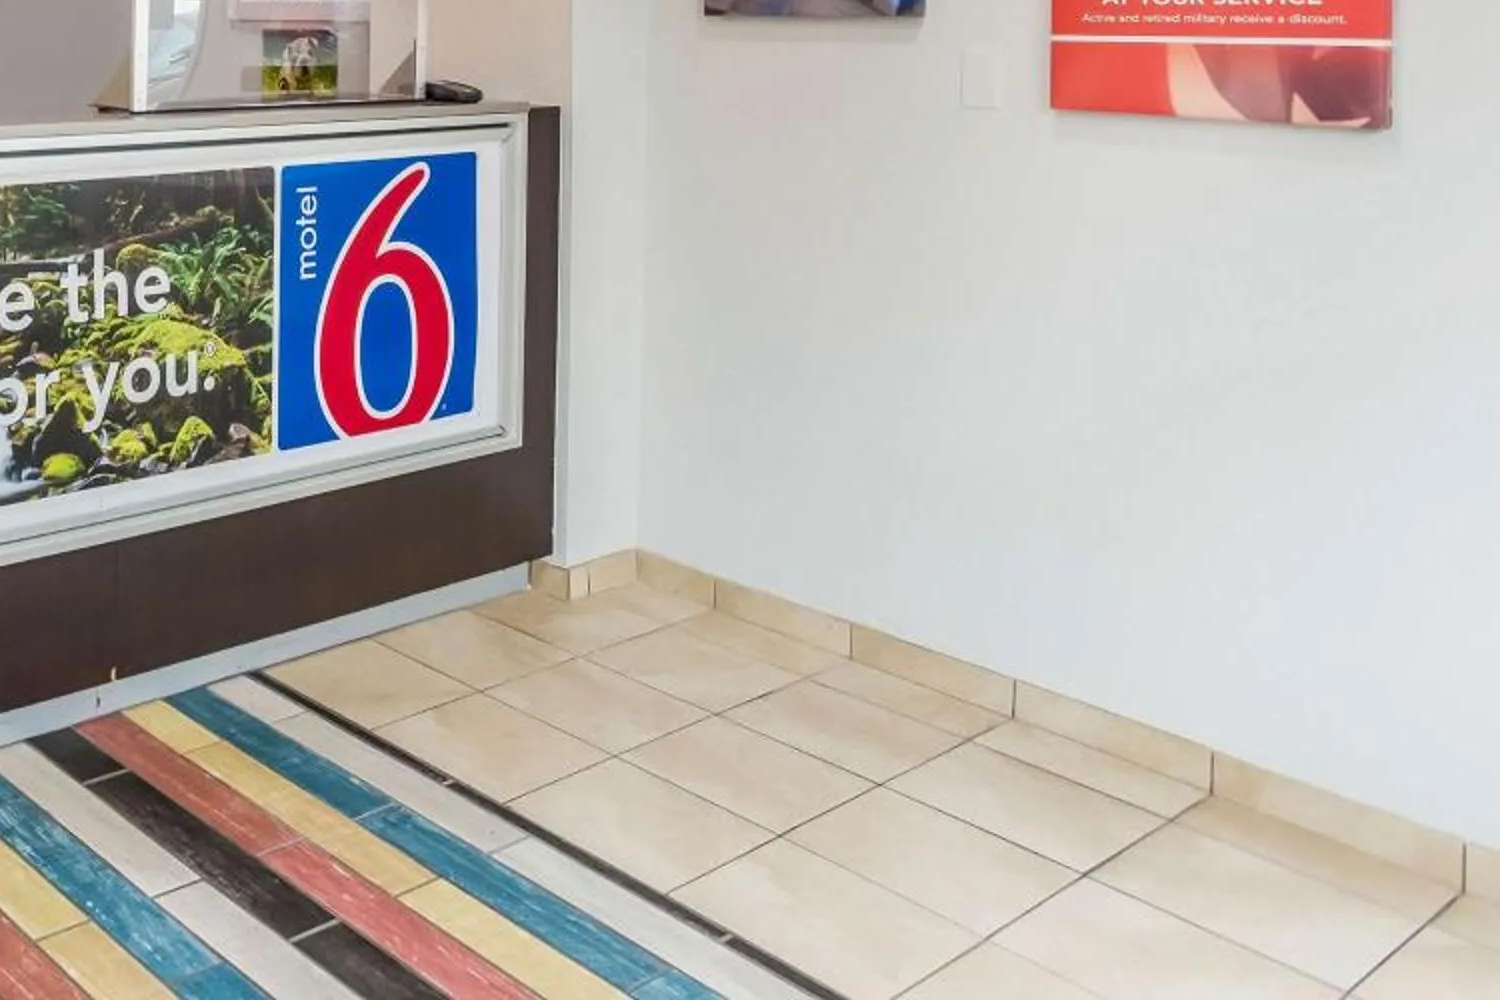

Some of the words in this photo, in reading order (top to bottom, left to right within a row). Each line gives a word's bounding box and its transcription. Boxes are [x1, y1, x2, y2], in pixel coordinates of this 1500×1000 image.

[1082, 12, 1115, 24] Active
[1118, 13, 1139, 24] and
[1142, 12, 1181, 24] retired
[1183, 12, 1226, 26] military
[1229, 13, 1273, 24] receive
[1278, 14, 1285, 24] a
[1289, 13, 1348, 25] discount.
[295, 186, 318, 280] motel
[60, 248, 172, 324] the
[313, 161, 455, 438] 6
